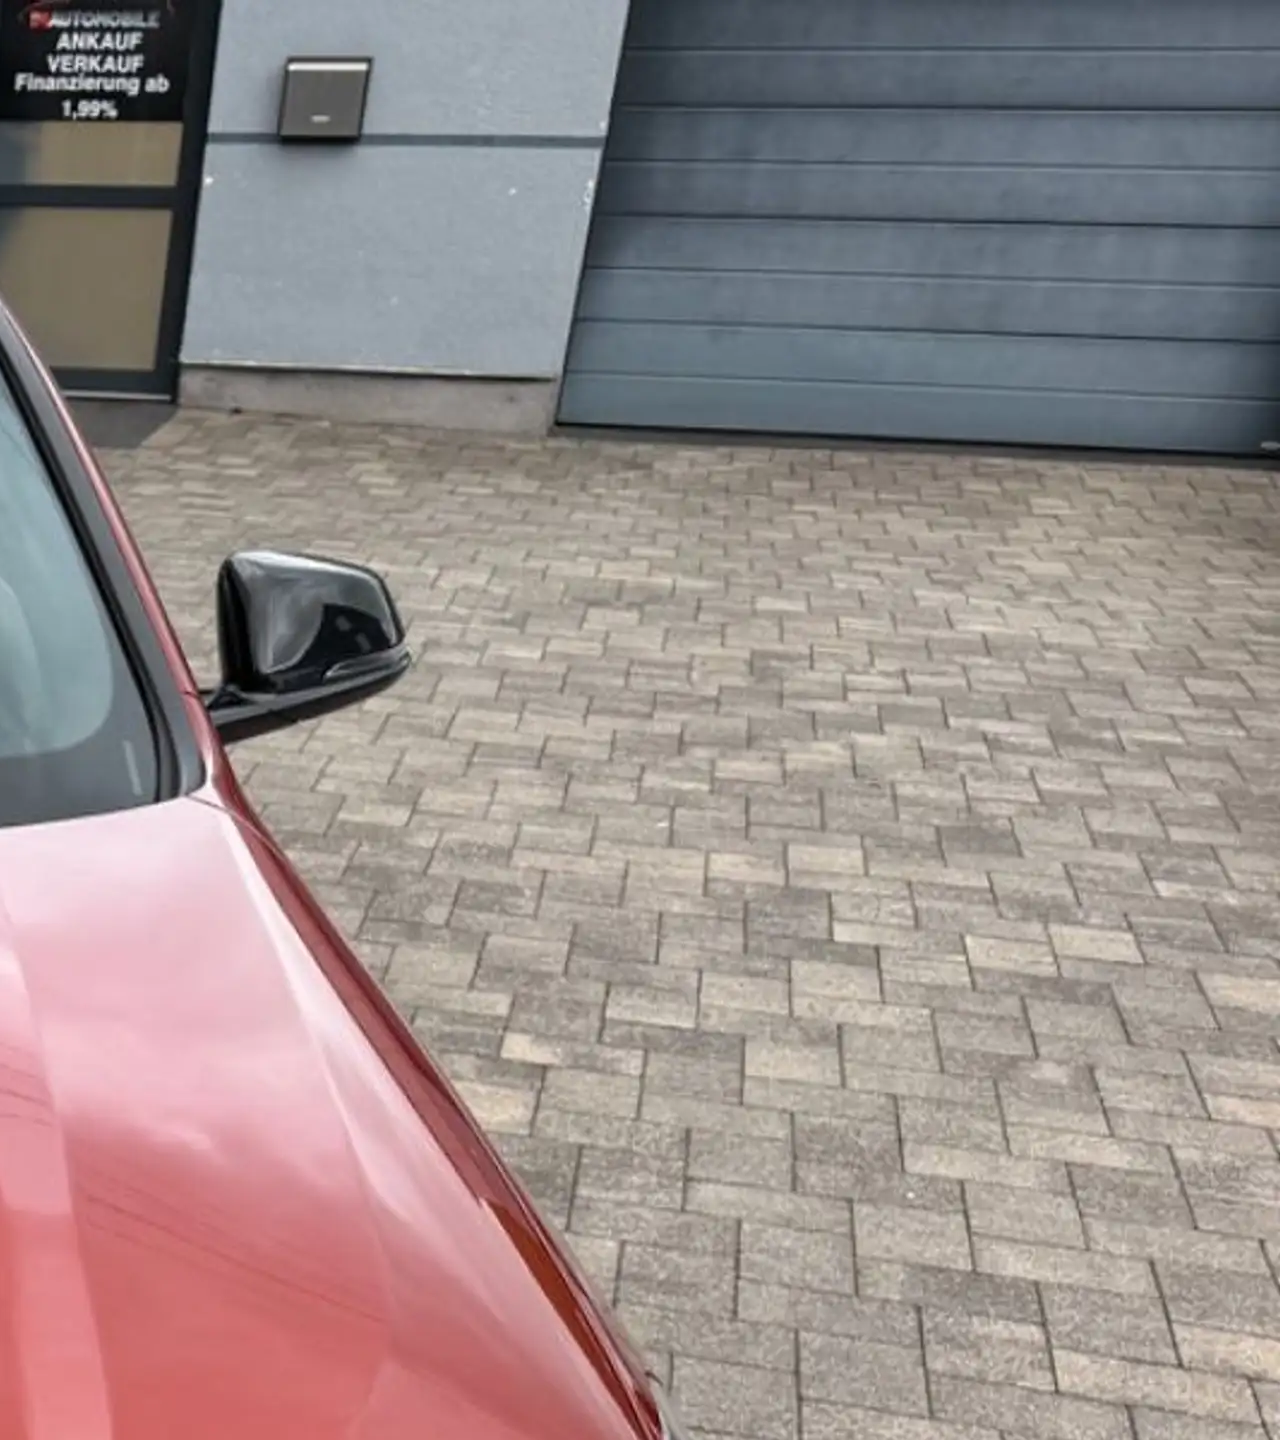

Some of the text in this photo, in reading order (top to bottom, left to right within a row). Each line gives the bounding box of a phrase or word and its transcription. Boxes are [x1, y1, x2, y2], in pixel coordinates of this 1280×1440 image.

[56, 31, 143, 51] ANKAUF
[47, 53, 144, 73] VERKAUF
[14, 72, 170, 96] Finanzierung ab
